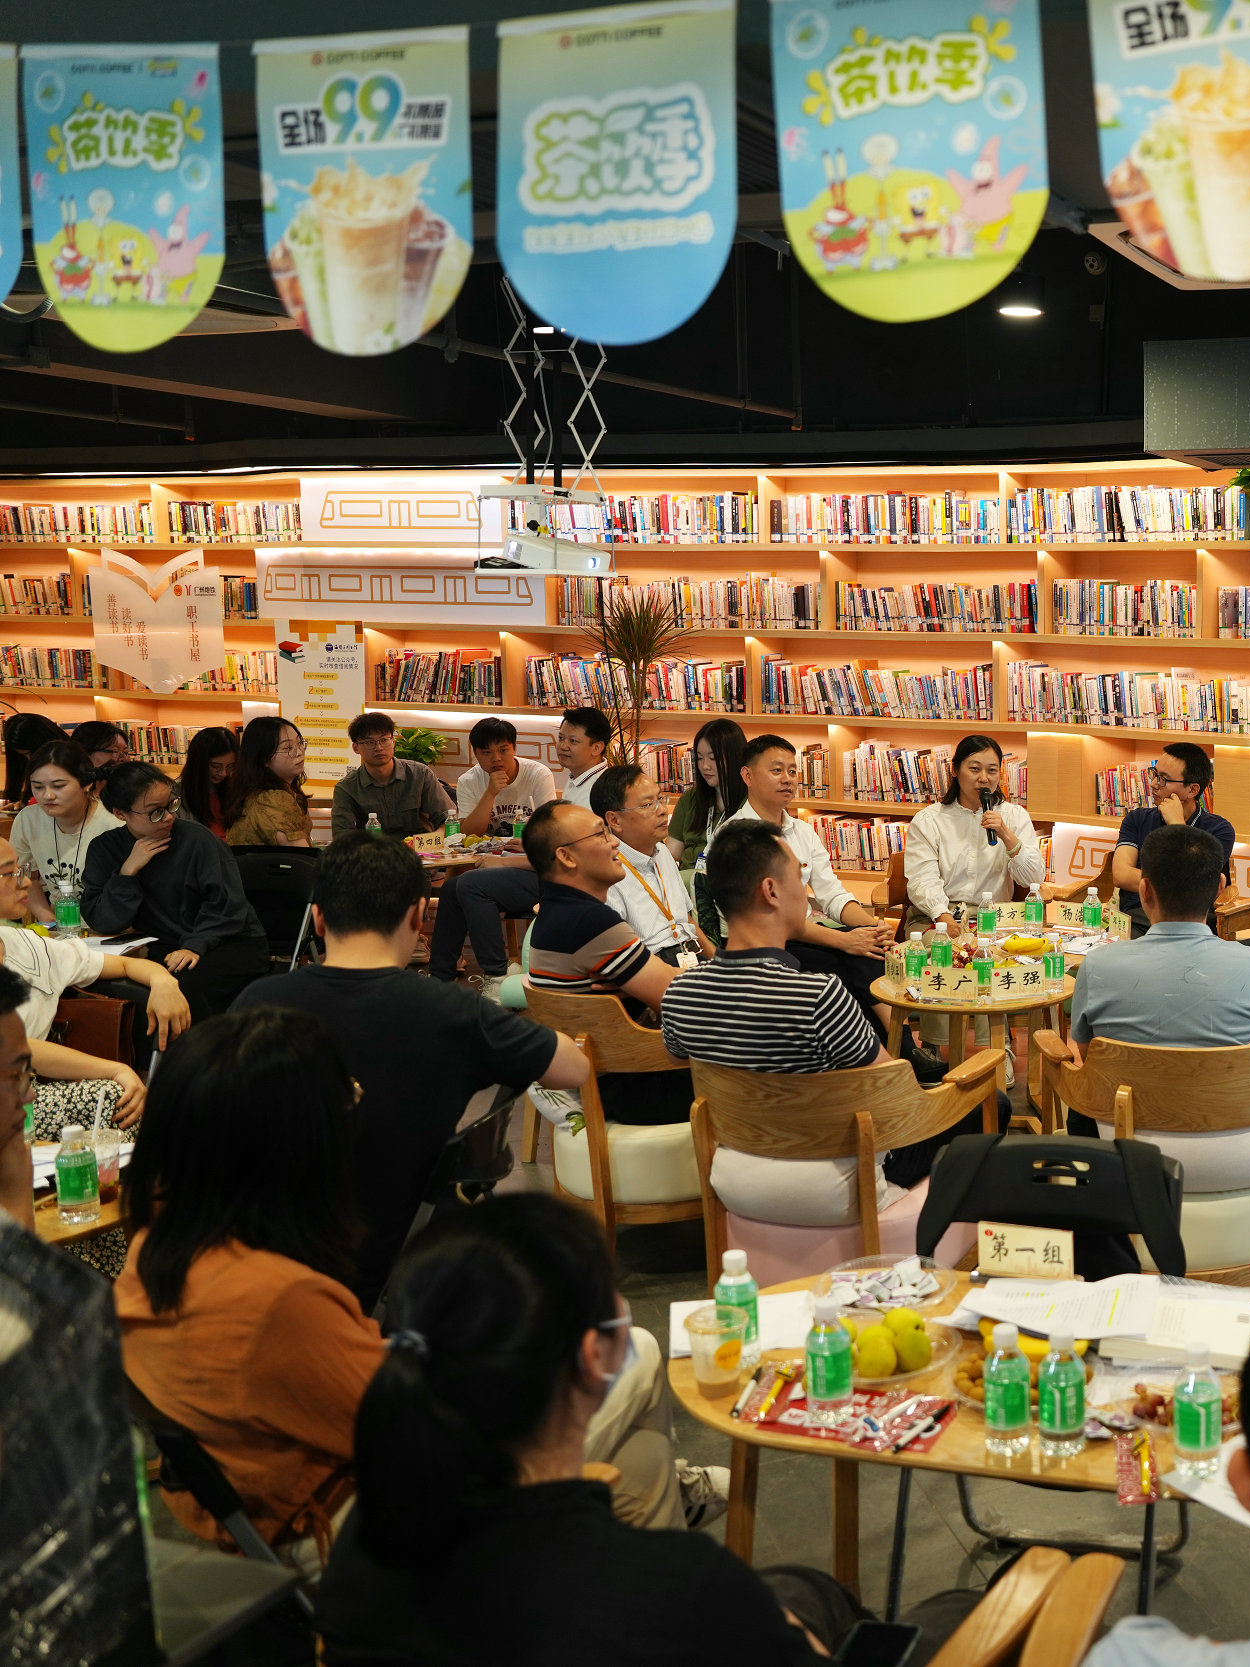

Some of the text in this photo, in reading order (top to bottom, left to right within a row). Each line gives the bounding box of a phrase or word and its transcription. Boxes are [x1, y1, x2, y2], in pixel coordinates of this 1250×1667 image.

[575, 25, 664, 47] COTTI COFFEE
[1122, 1, 1190, 50] 全场
[99, 63, 134, 74] COFFEE
[326, 48, 407, 65] COTTI COFFEE
[832, 38, 981, 110] 茶饮季
[66, 112, 180, 166] 茶饮季
[280, 107, 327, 148] 全场
[525, 93, 708, 207] 茶饮季
[193, 585, 217, 594] 广州地铁
[106, 593, 119, 634] 善读书
[121, 607, 134, 648] 读好书
[186, 605, 201, 662] 职工书屋
[136, 620, 149, 661] 爱读书
[417, 835, 442, 850] 第四组
[927, 971, 973, 992] 李广
[997, 970, 1041, 990] 李强
[990, 1232, 1065, 1265] 第一组
